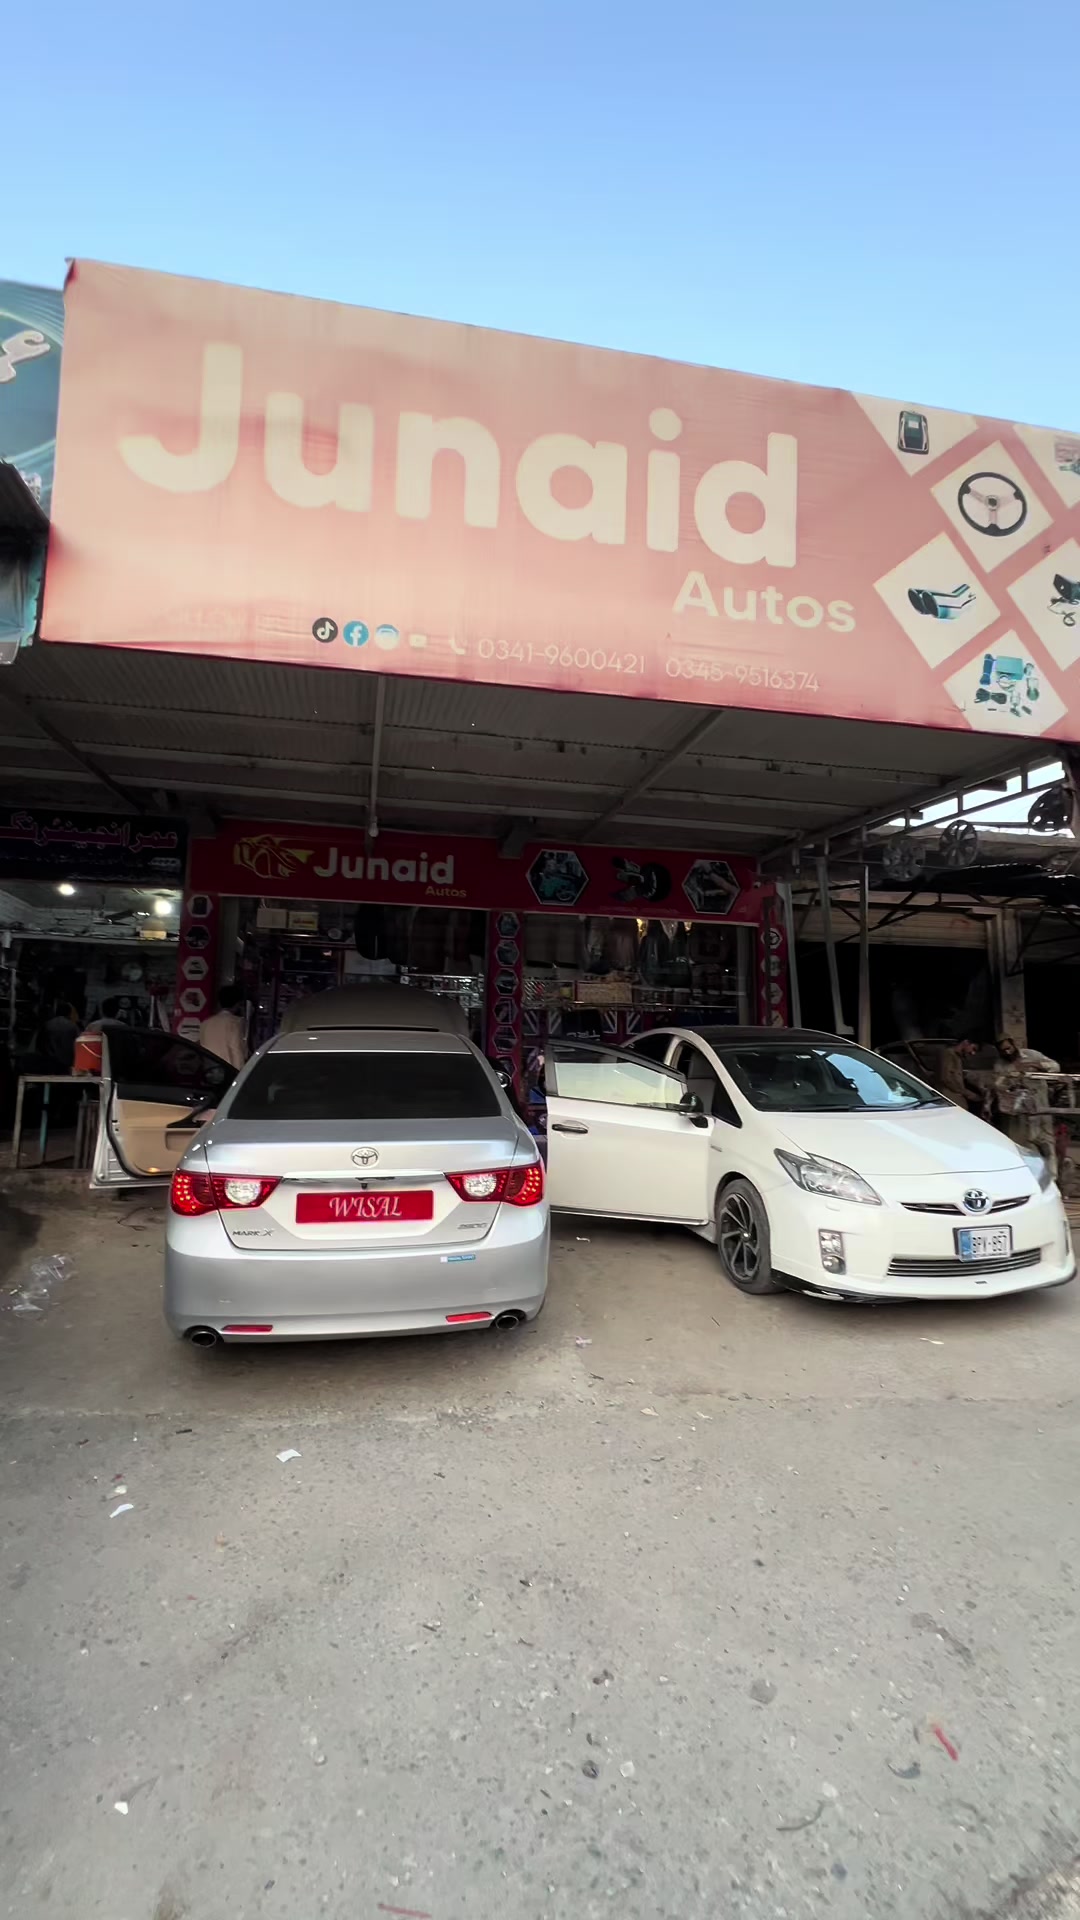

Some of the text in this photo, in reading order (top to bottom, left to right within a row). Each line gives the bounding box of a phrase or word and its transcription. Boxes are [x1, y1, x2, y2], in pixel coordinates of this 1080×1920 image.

[119, 342, 798, 568] Junaid
[673, 571, 856, 633] Autos
[477, 637, 646, 674] 0341-9600421
[313, 847, 454, 885] Junaid
[425, 885, 467, 898] Autos
[329, 1196, 402, 1218] WISAL
